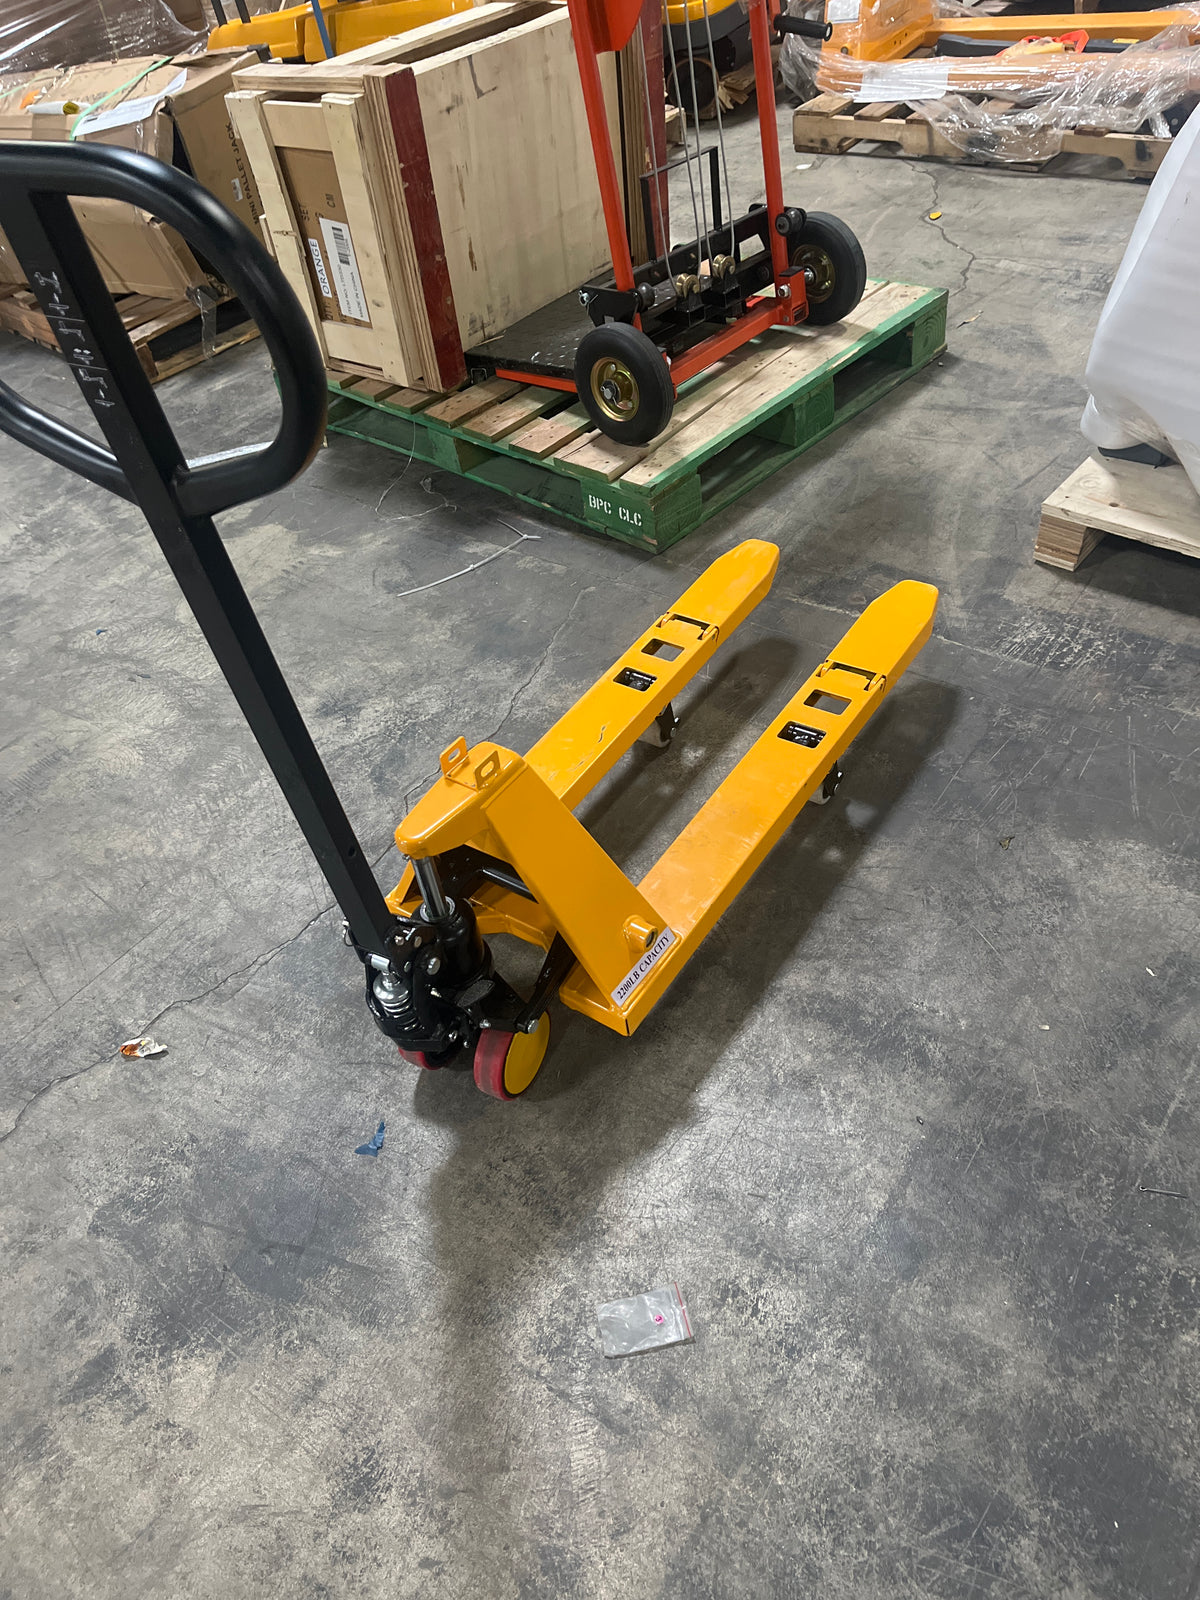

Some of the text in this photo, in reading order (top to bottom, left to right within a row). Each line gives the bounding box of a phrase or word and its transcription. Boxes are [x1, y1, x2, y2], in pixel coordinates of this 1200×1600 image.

[226, 122, 240, 154] JACK
[236, 157, 253, 200] PALLET
[248, 201, 260, 224] MINI
[309, 240, 330, 295] ORANGE
[588, 494, 642, 527] BPC CLC
[616, 933, 670, 1000] 2200LB CAPACITY
